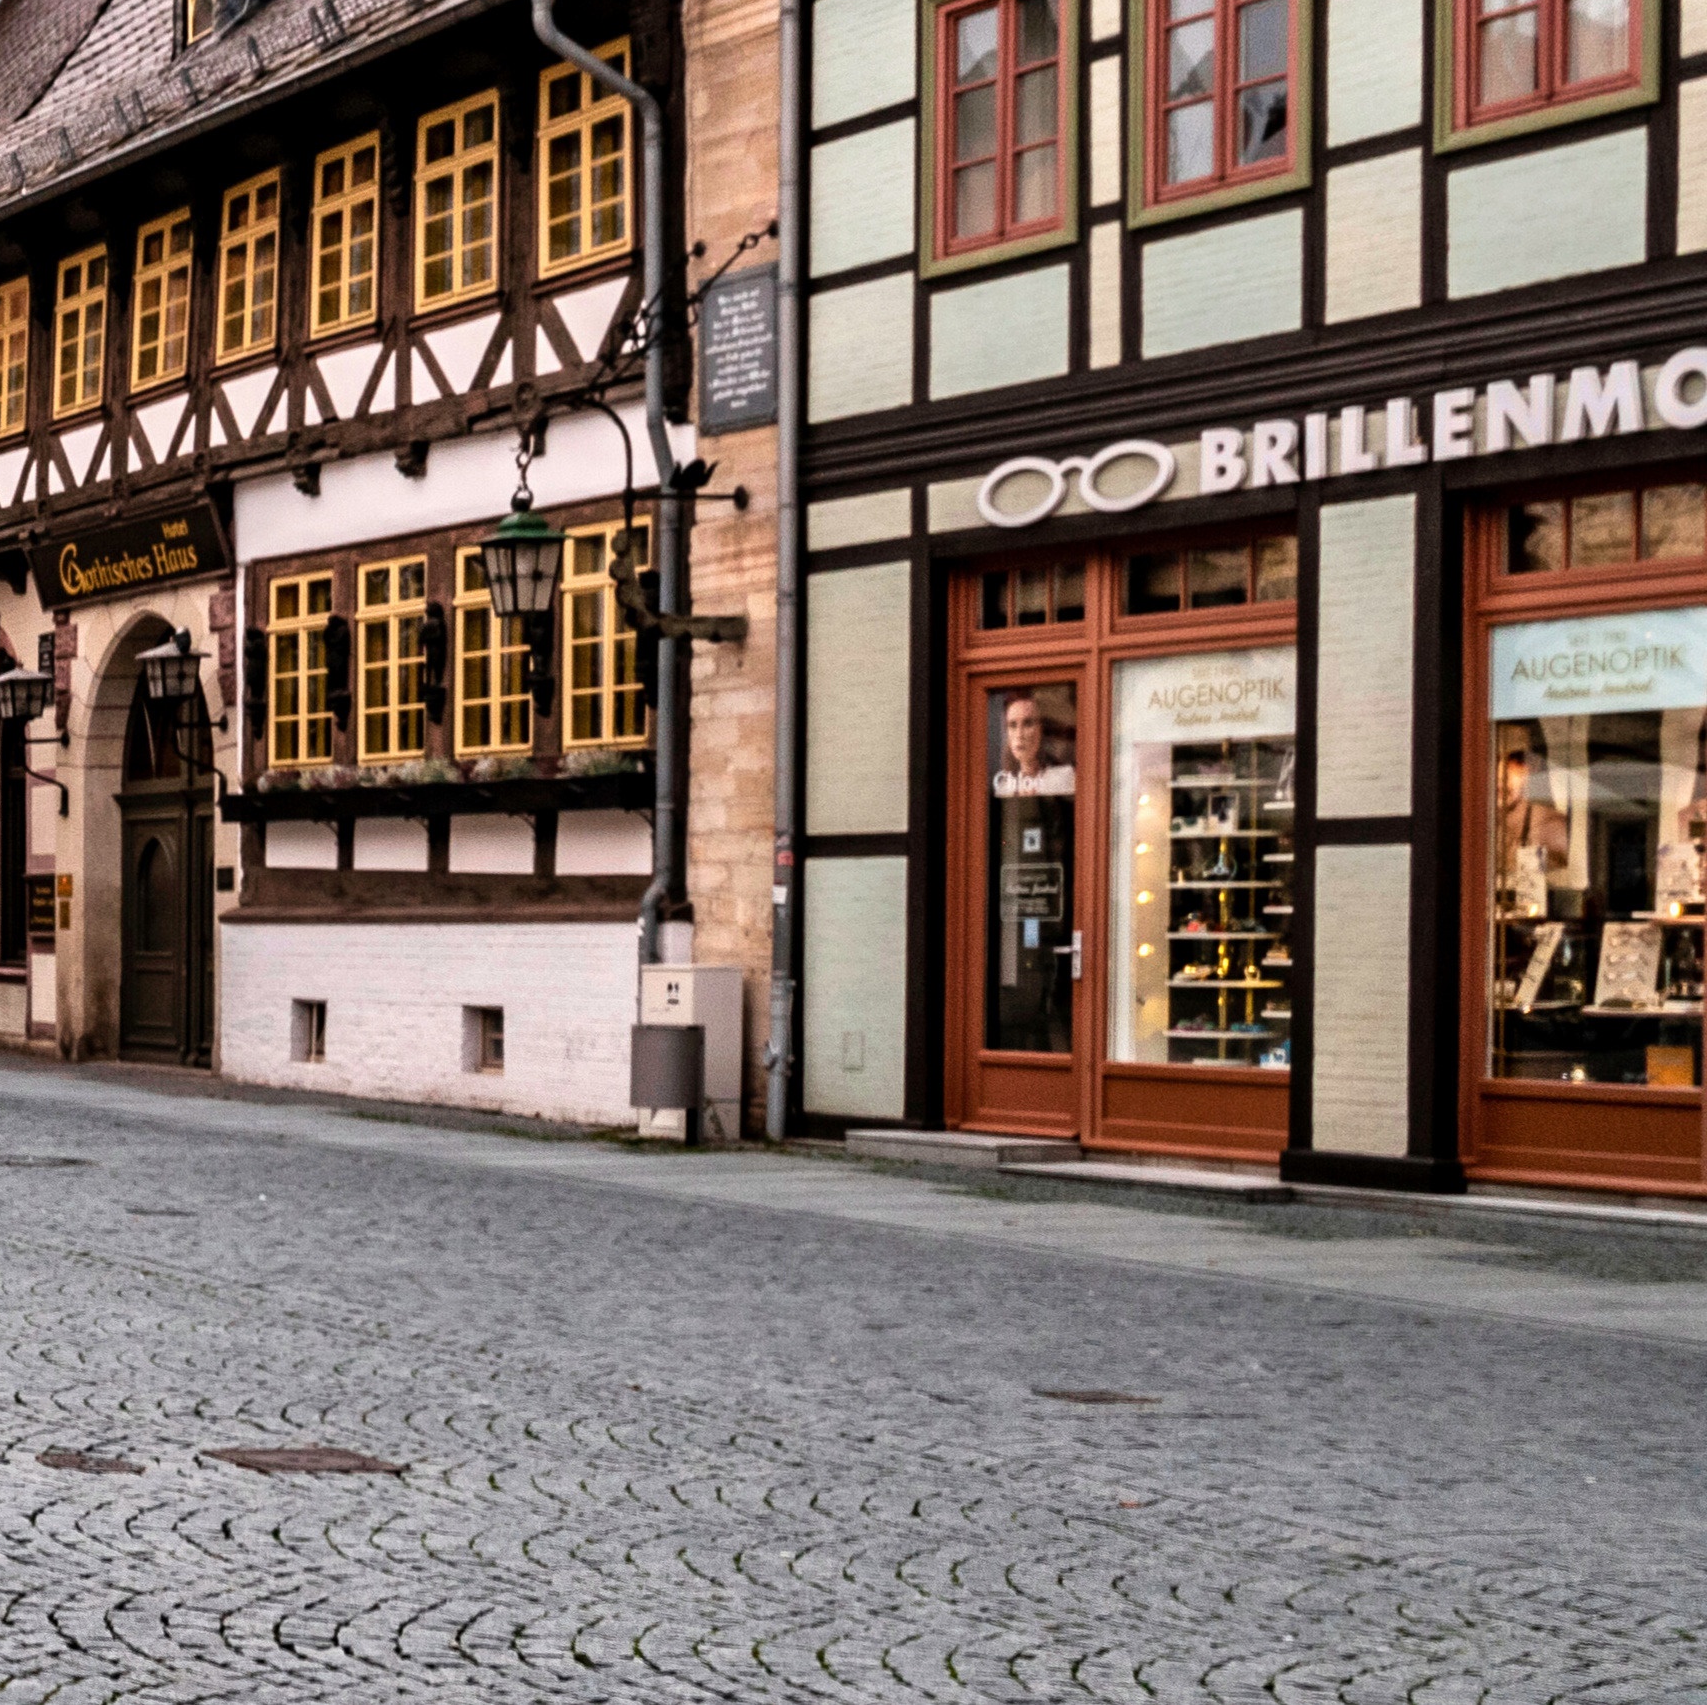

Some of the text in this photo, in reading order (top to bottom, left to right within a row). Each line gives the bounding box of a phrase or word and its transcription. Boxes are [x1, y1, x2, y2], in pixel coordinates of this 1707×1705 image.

[161, 518, 189, 540] Hotel
[59, 543, 199, 595] Gothisches Haus
[1510, 644, 1686, 683] AUGENOPTIK
[1148, 676, 1286, 710] AUGENOPTIK
